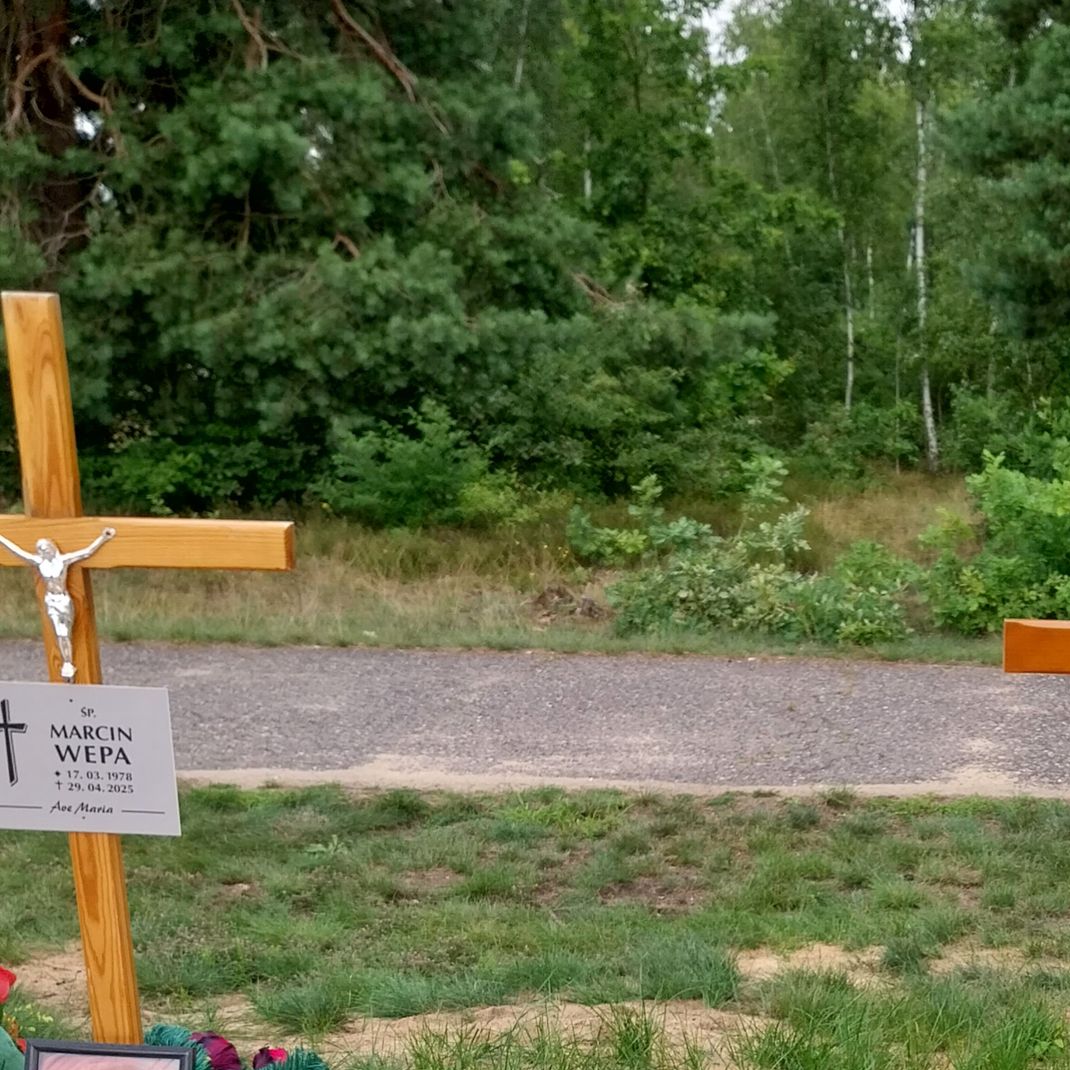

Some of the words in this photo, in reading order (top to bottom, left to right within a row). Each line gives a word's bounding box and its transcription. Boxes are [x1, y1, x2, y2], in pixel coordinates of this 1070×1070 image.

[50, 724, 133, 742] MARCIN
[54, 744, 131, 765] WEPA
[49, 800, 72, 814] Ave
[74, 802, 113, 815] Maria
